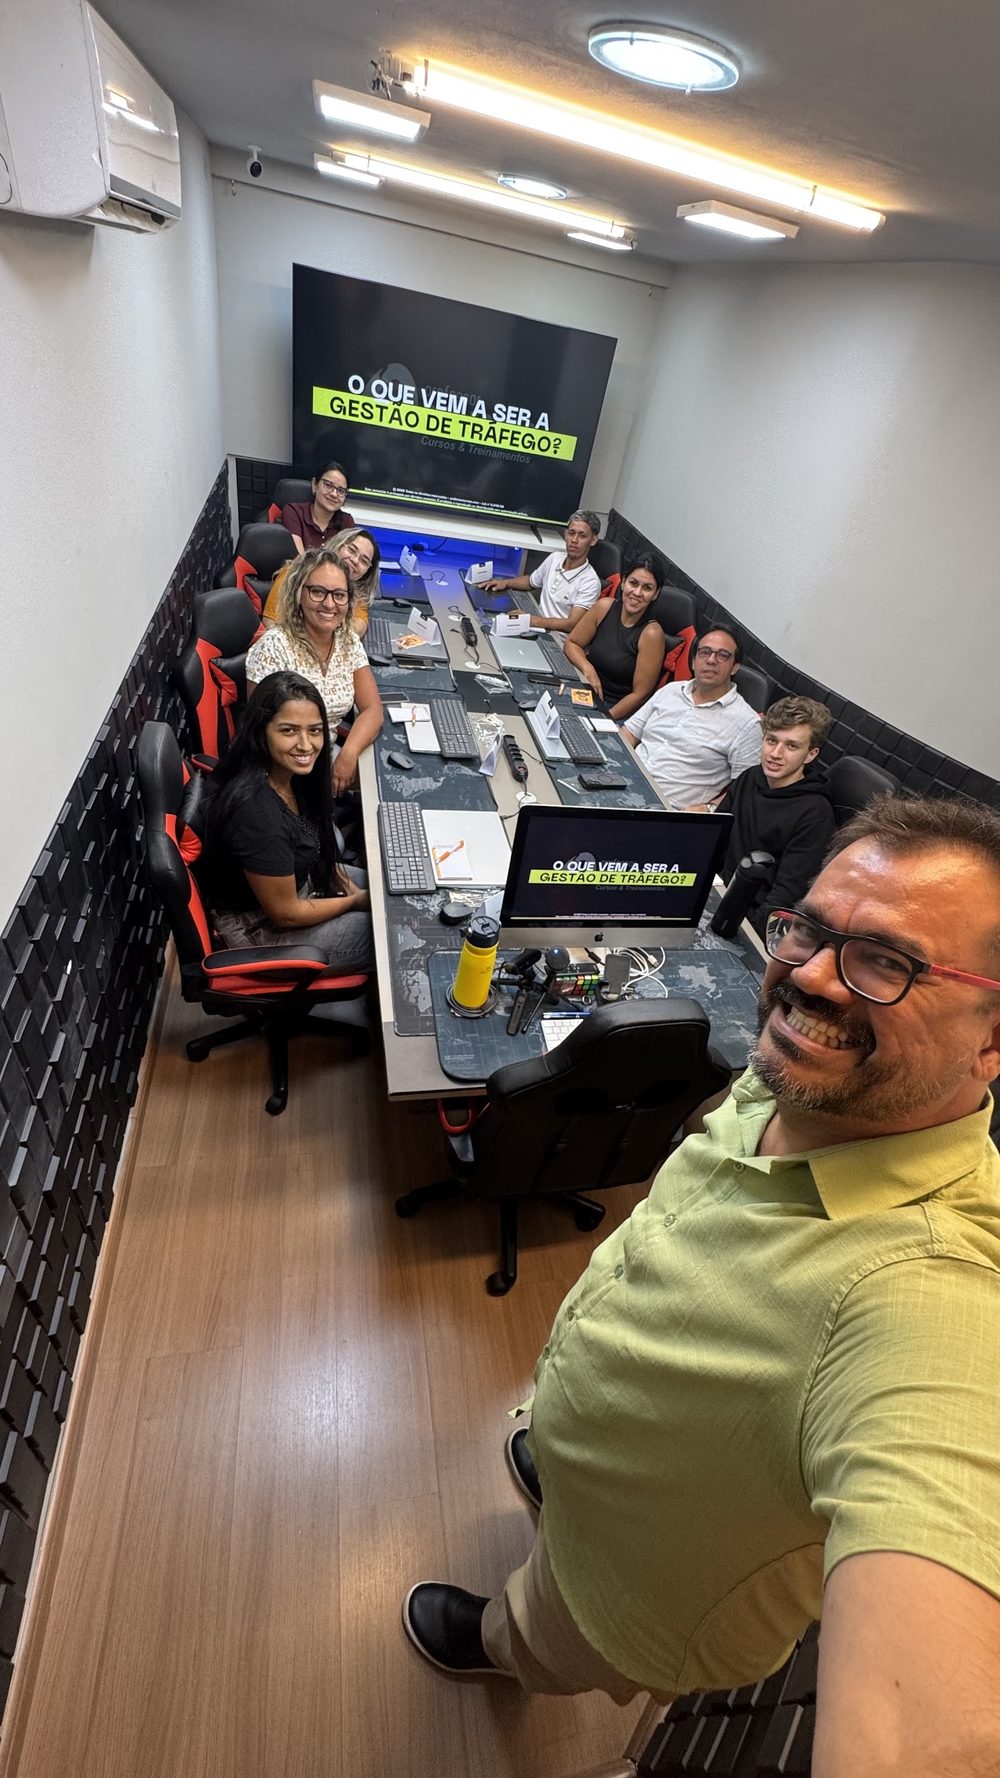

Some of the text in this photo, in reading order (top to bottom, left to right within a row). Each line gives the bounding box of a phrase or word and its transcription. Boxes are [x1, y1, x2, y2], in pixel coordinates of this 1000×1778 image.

[348, 374, 365, 394] O
[370, 379, 415, 405] QUE
[421, 388, 468, 415] VEM
[472, 400, 487, 419] A
[492, 403, 531, 427] SER
[535, 413, 550, 431] A
[329, 396, 562, 455] GESTÃO DE TRÁFEGO?
[552, 860, 564, 871] O
[567, 861, 596, 872] QUE
[598, 861, 628, 873] VEM
[630, 862, 640, 873] A
[642, 863, 667, 873] SER
[669, 864, 680, 873] A
[599, 873, 616, 883] DE
[620, 872, 687, 885] TRÁFEGO?
